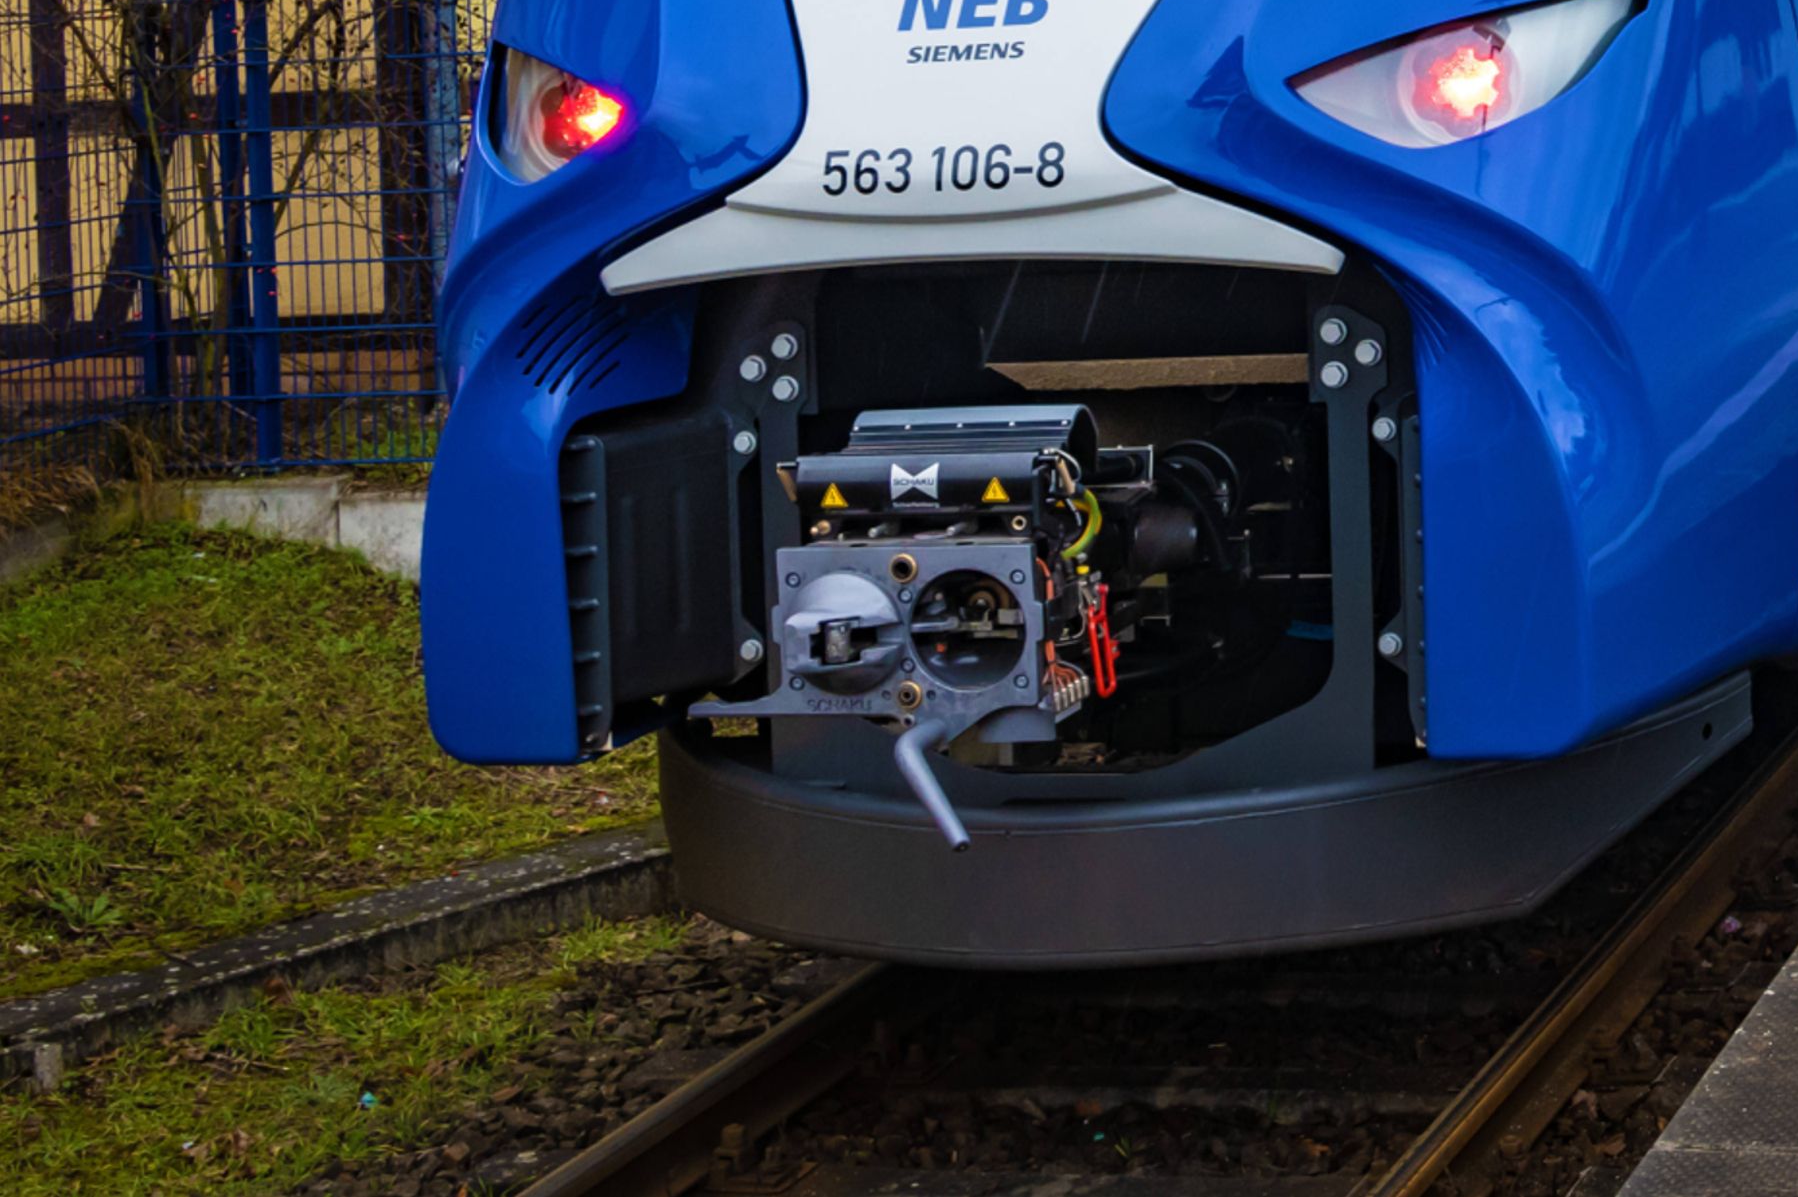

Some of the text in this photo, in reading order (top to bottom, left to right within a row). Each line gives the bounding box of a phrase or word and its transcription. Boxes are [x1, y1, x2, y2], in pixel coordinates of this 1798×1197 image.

[906, 40, 1025, 64] SIEMENS
[821, 141, 1066, 196] 563 106-8
